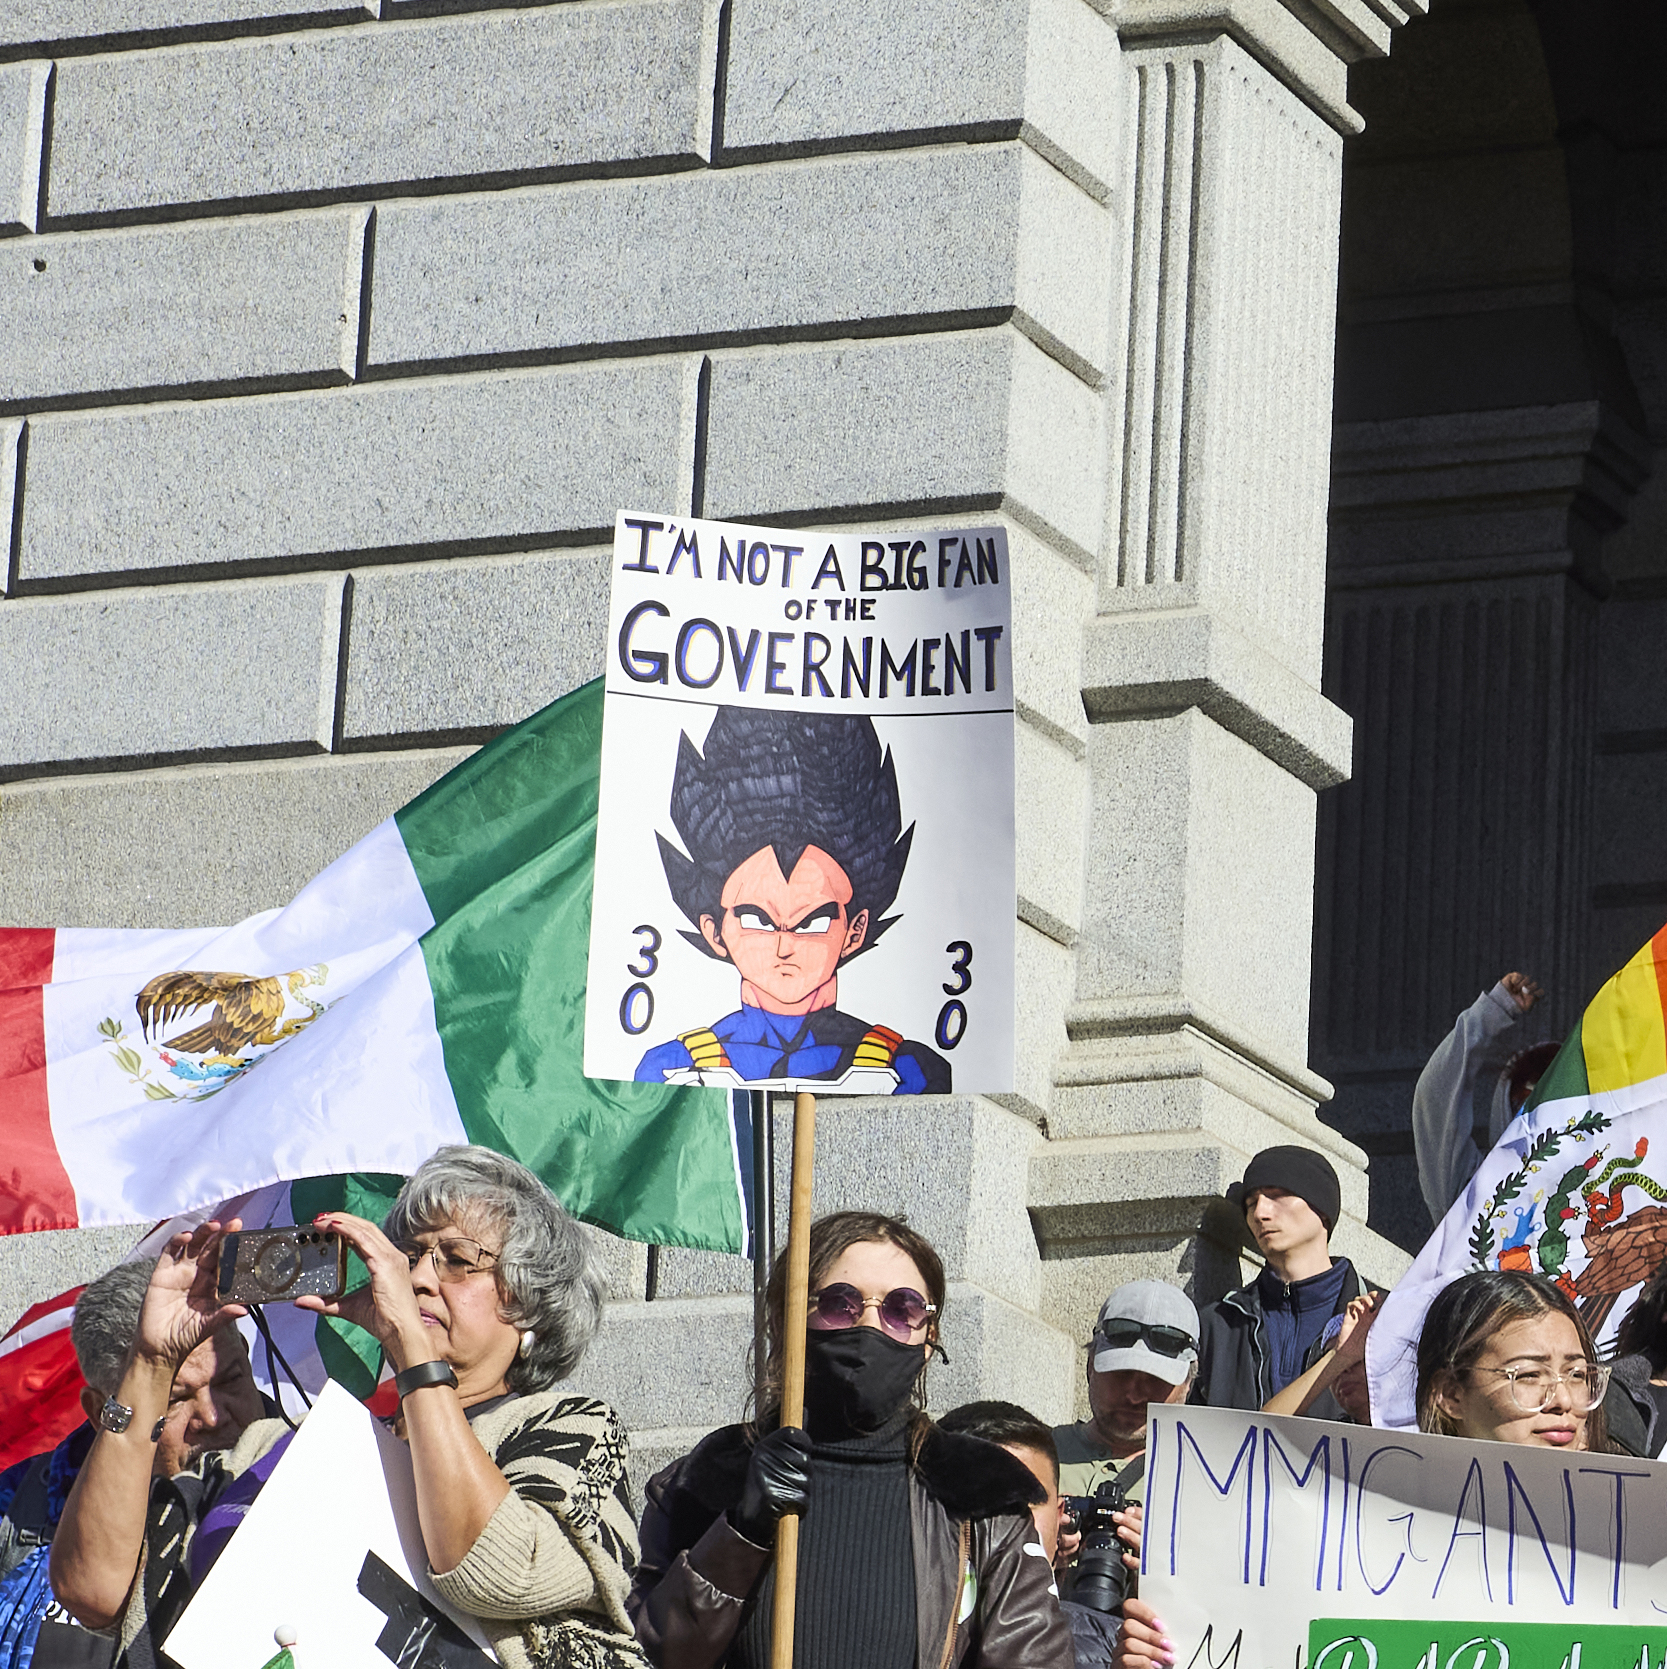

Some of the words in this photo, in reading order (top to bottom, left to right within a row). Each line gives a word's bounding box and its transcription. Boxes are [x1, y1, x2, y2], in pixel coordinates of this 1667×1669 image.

[622, 518, 702, 579] I'M
[717, 535, 804, 588] NOT
[811, 543, 846, 592] A
[860, 541, 929, 592] BIG
[938, 537, 999, 589] FAN
[784, 599, 817, 621] OF
[824, 598, 877, 621] THE
[618, 600, 1003, 699] GOVERNMENT
